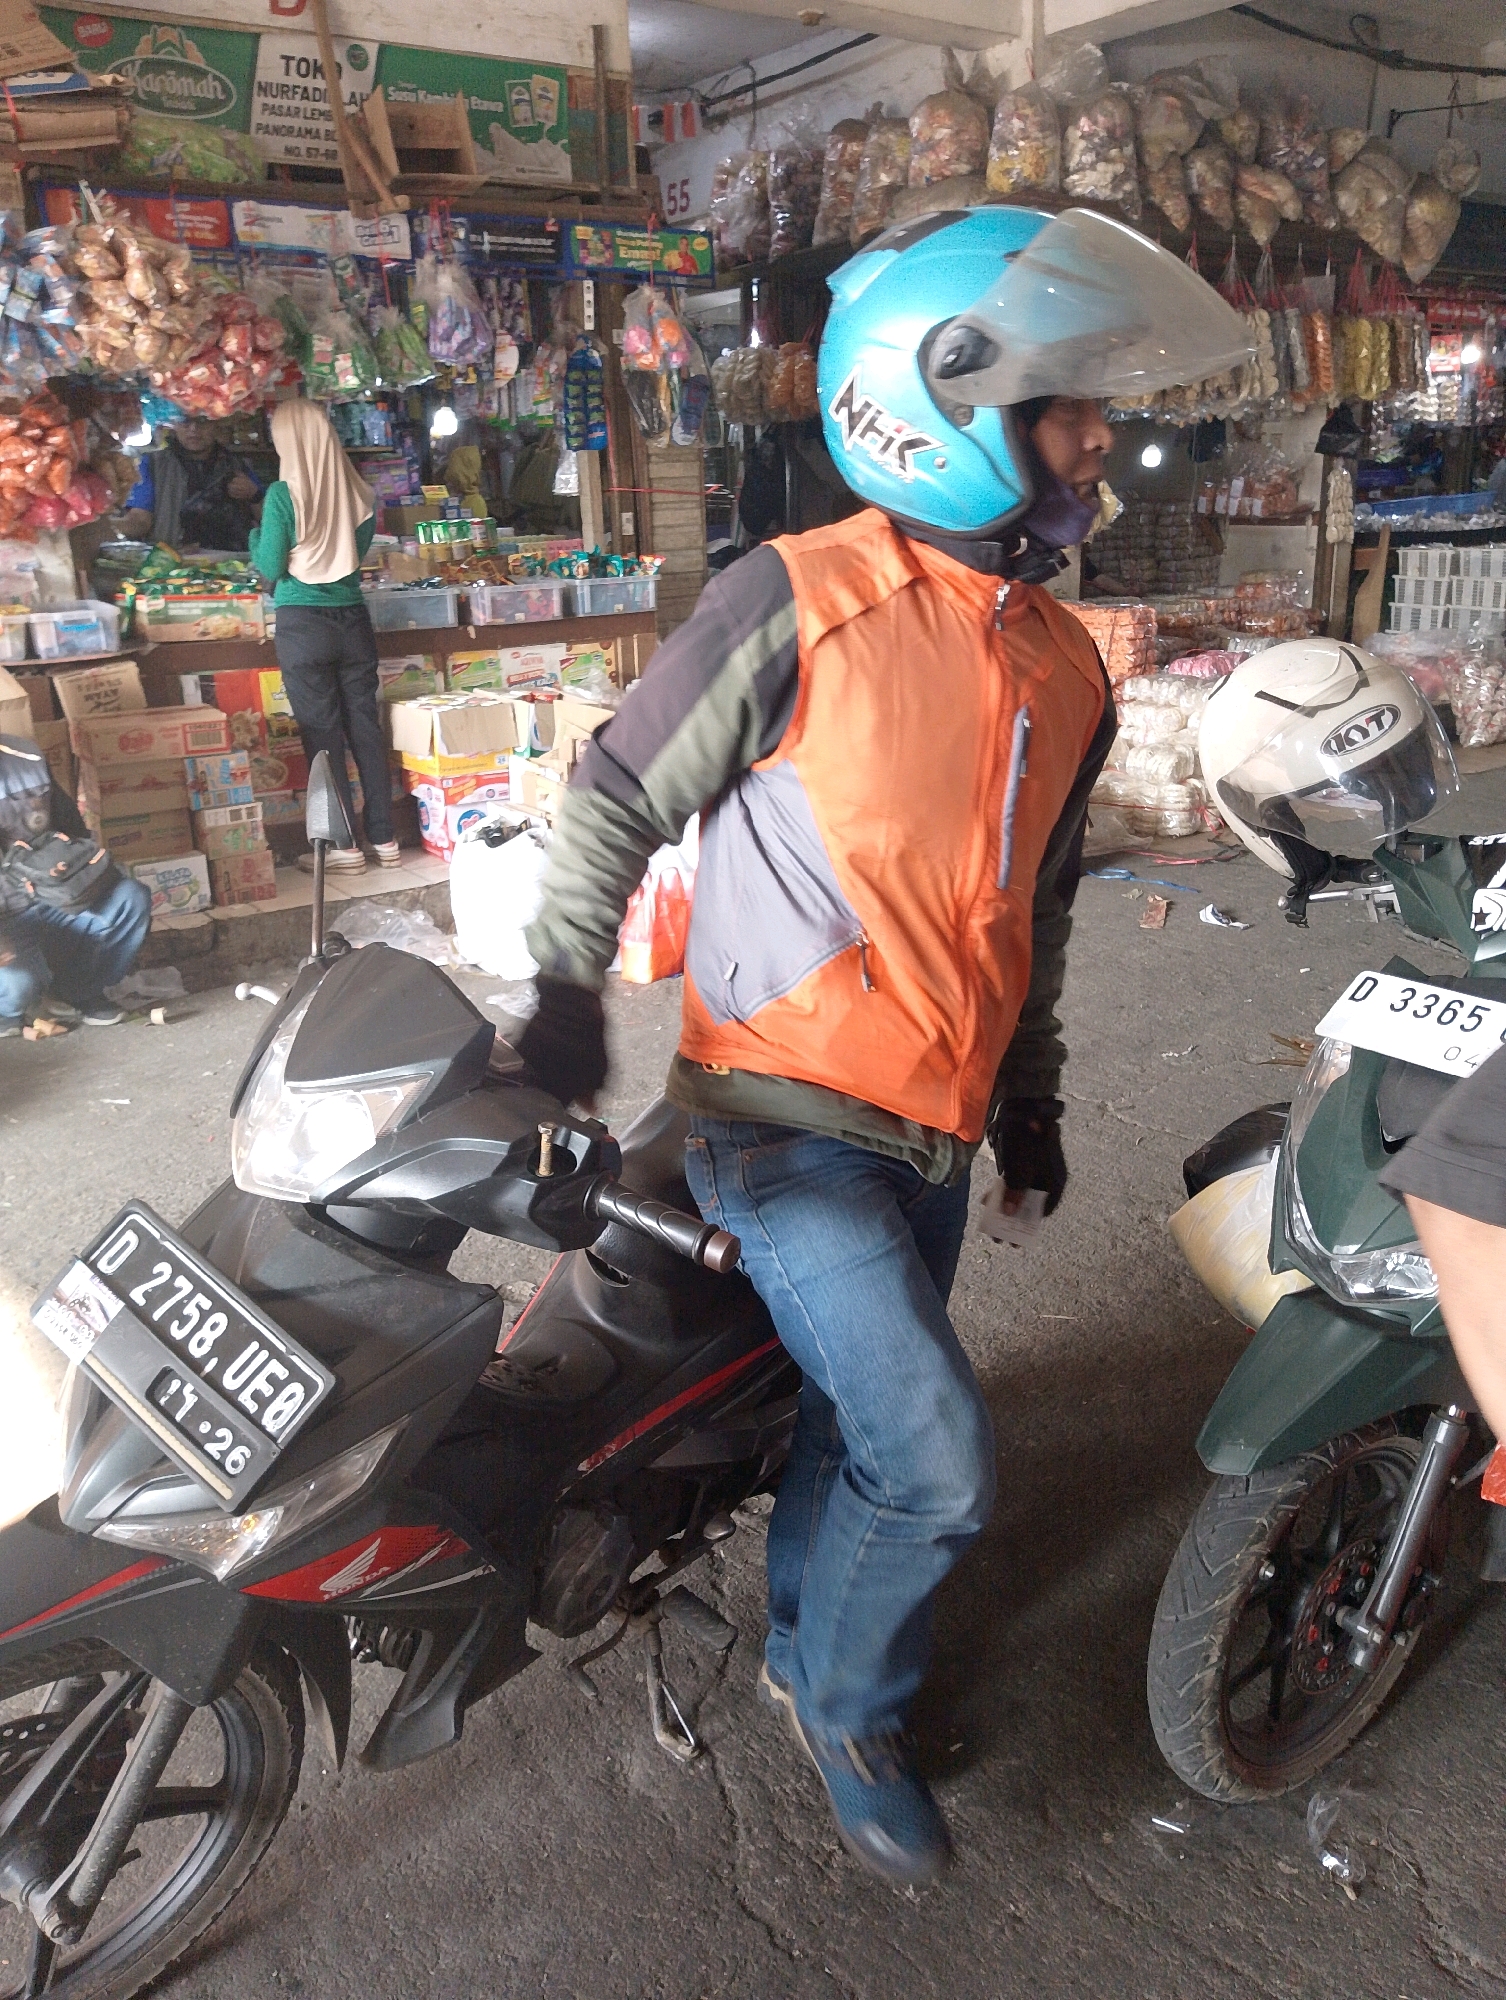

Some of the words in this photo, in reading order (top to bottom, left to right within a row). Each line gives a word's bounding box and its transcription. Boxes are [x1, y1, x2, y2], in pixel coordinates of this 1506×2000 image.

[667, 178, 691, 216] 55
[1328, 707, 1388, 754] KYT
[1347, 976, 1379, 1003] D
[1389, 987, 1491, 1033] 3365
[96, 1228, 140, 1276] D
[128, 1261, 229, 1359] 2758
[323, 1566, 392, 1601] HONDA
